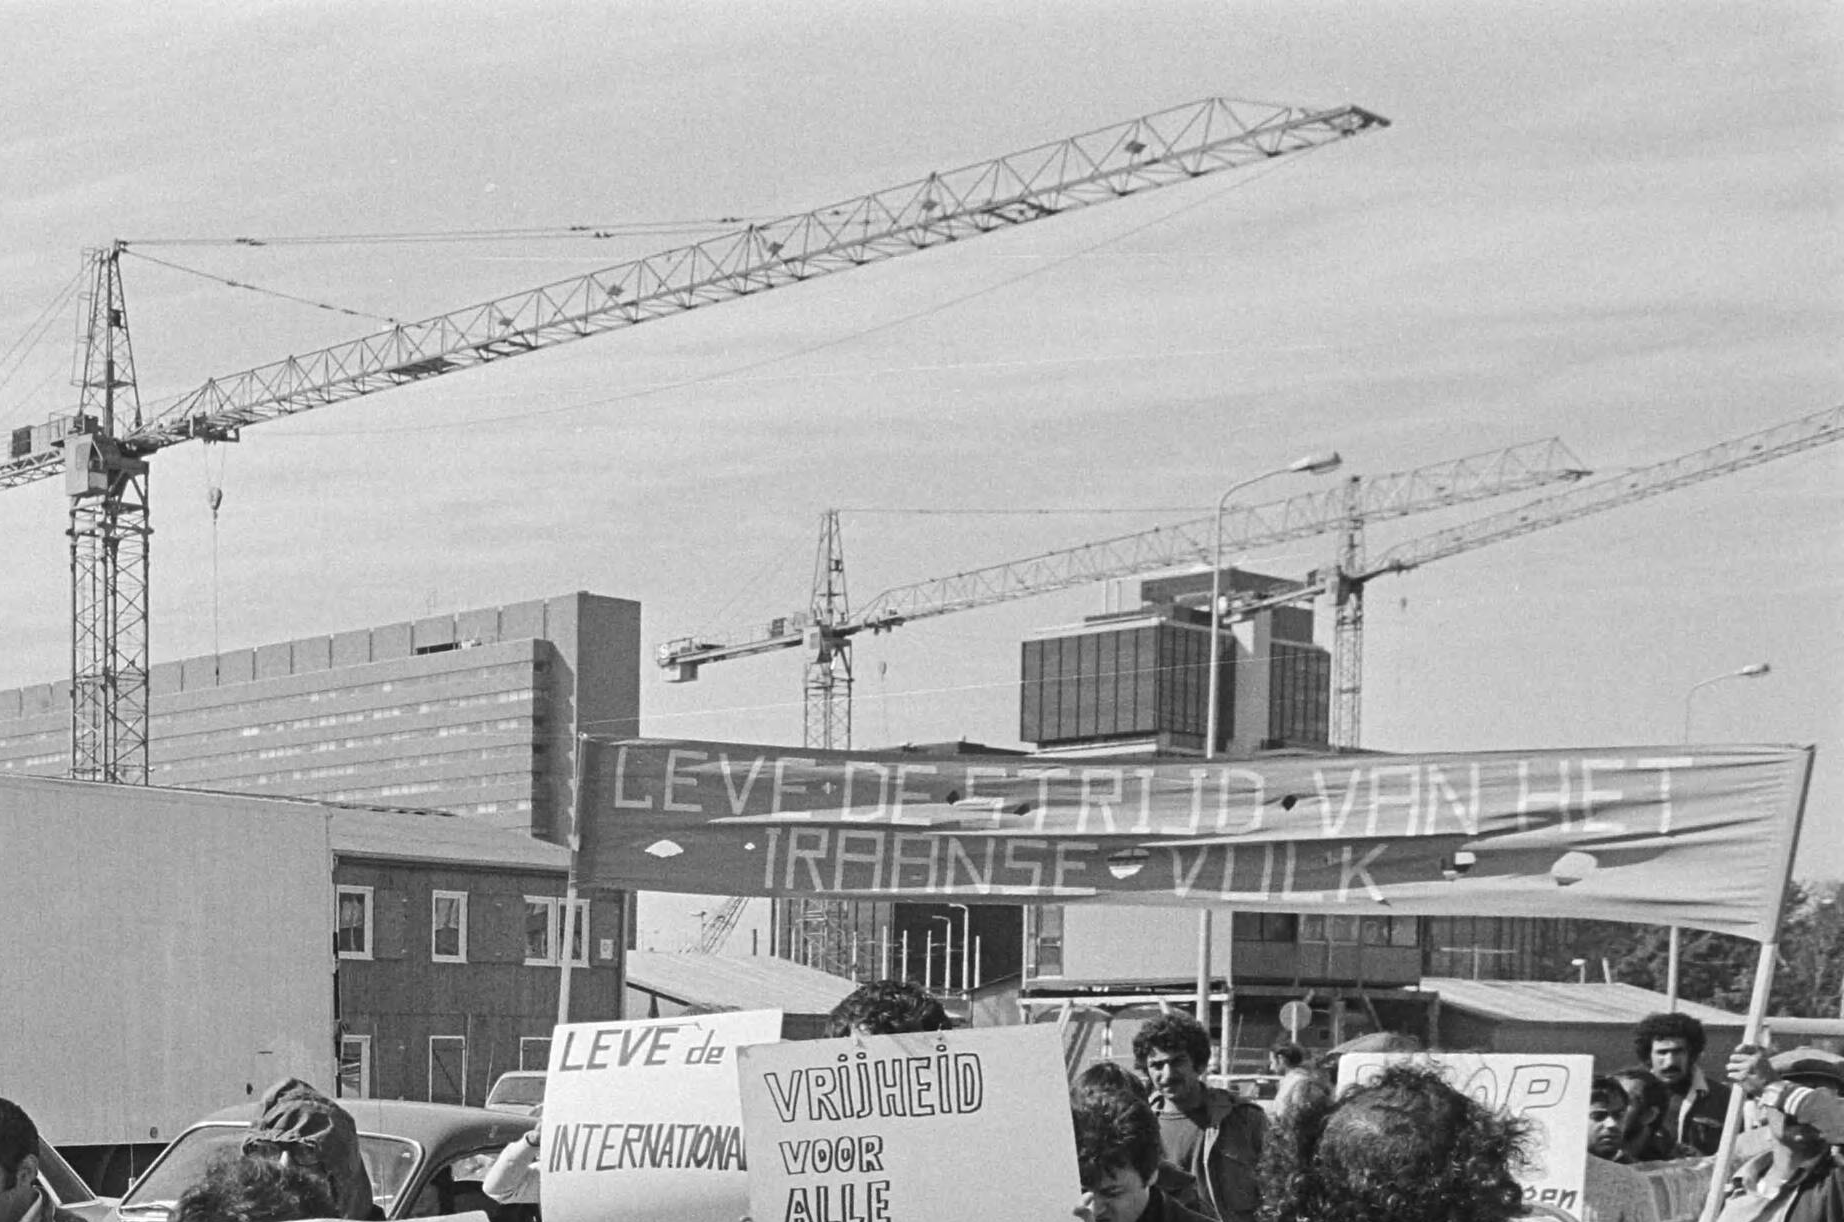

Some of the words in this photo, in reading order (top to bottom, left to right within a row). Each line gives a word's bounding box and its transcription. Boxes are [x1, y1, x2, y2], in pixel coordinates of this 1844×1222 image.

[614, 746, 817, 819] LEVE
[840, 761, 938, 825] DE
[1314, 763, 1480, 836] VAN
[1517, 756, 1694, 834] HET
[558, 1026, 678, 1072] LEVE
[685, 1035, 725, 1066] de
[778, 1135, 885, 1176] VOOR
